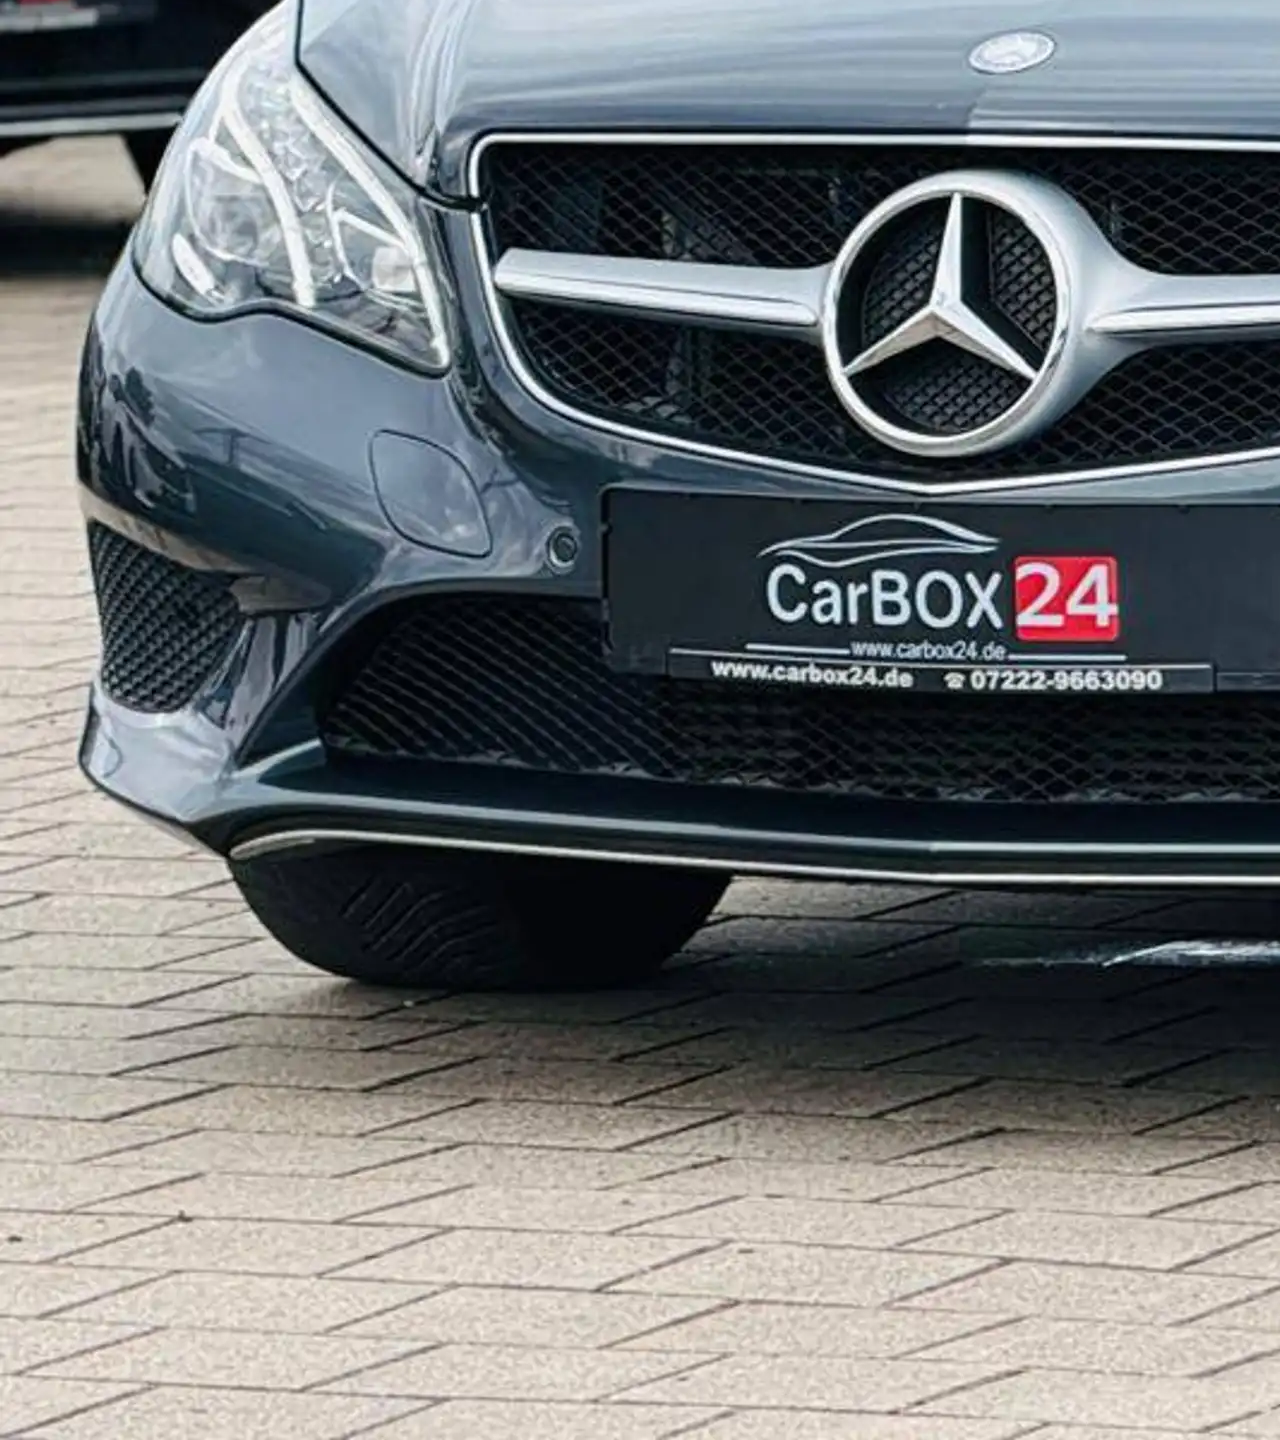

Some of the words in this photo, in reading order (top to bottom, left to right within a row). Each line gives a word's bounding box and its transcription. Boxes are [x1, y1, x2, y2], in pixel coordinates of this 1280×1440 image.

[851, 640, 1006, 660] www.carbox24.de
[711, 661, 914, 688] www.carbox24.de
[970, 669, 1163, 691] 07222-9663090
